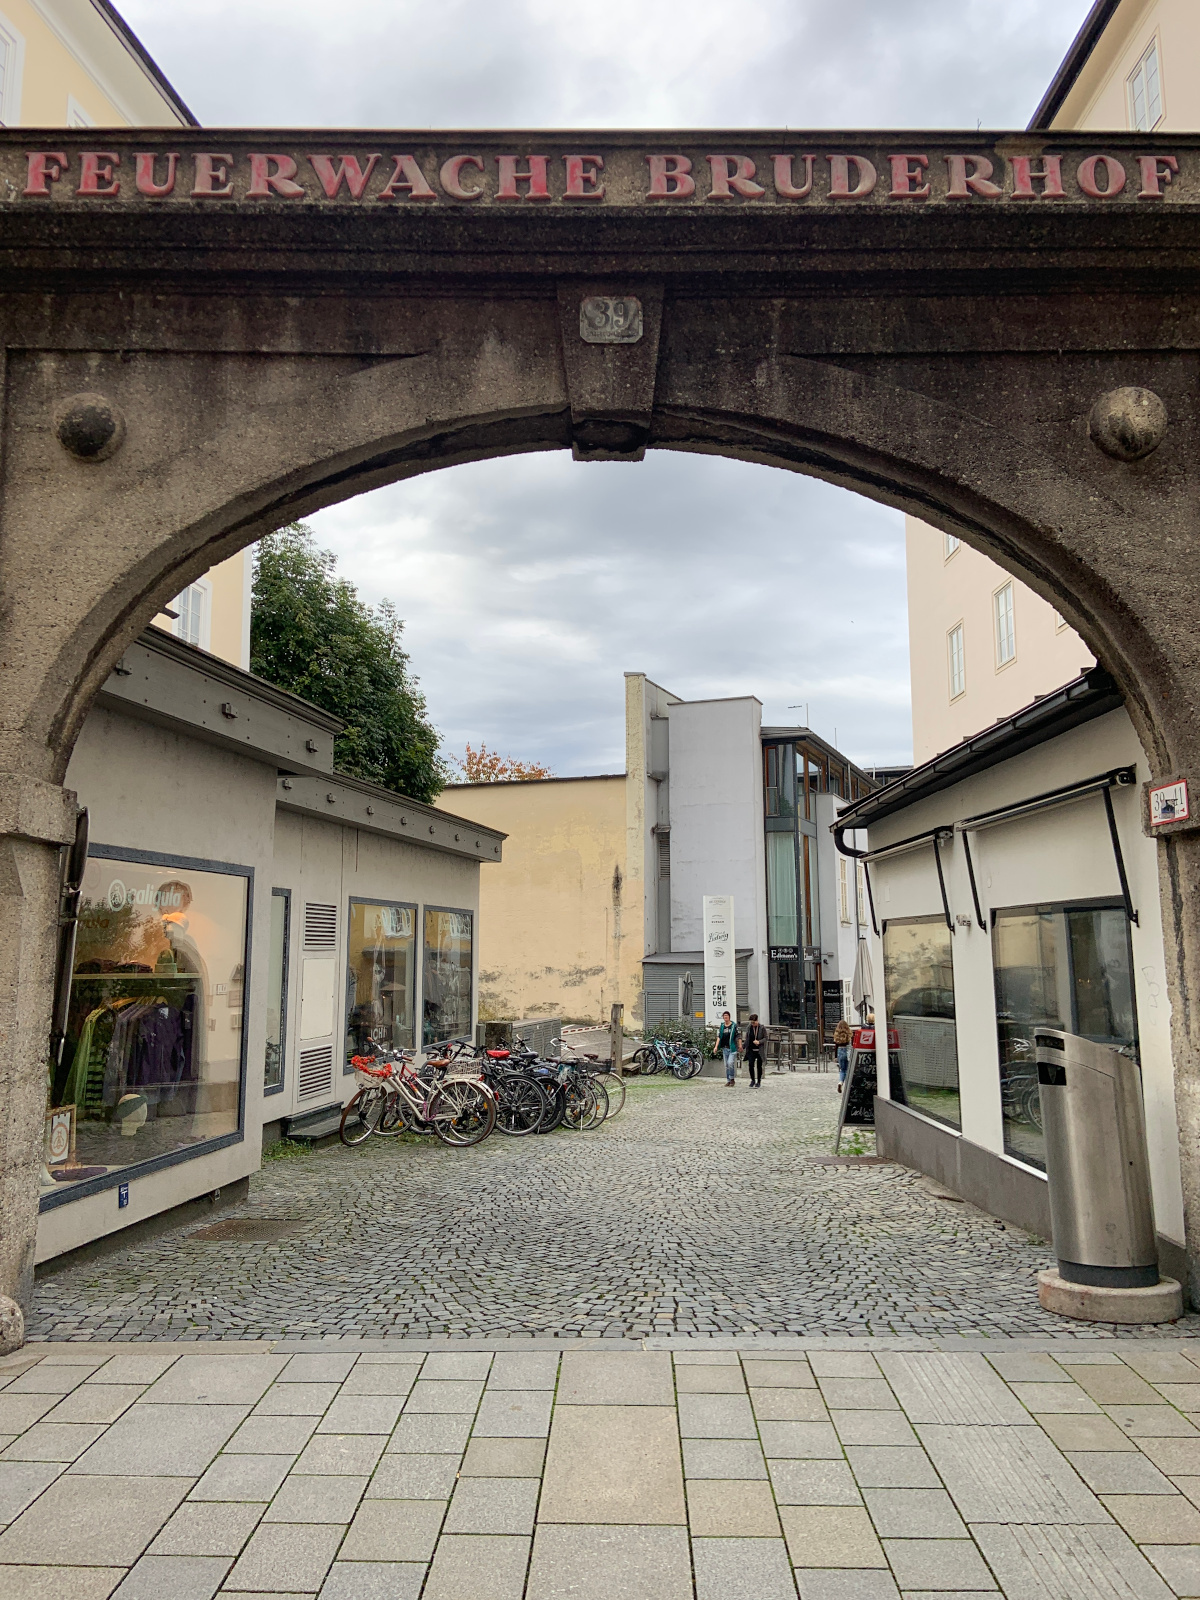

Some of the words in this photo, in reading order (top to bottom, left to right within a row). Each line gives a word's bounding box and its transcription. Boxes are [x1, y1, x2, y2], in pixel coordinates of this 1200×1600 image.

[21, 150, 606, 201] FEUERWACHE
[644, 153, 1180, 200] BRUDERHOF
[591, 300, 630, 329] 39
[127, 883, 181, 912] caligula
[858, 1053, 872, 1065] YES
